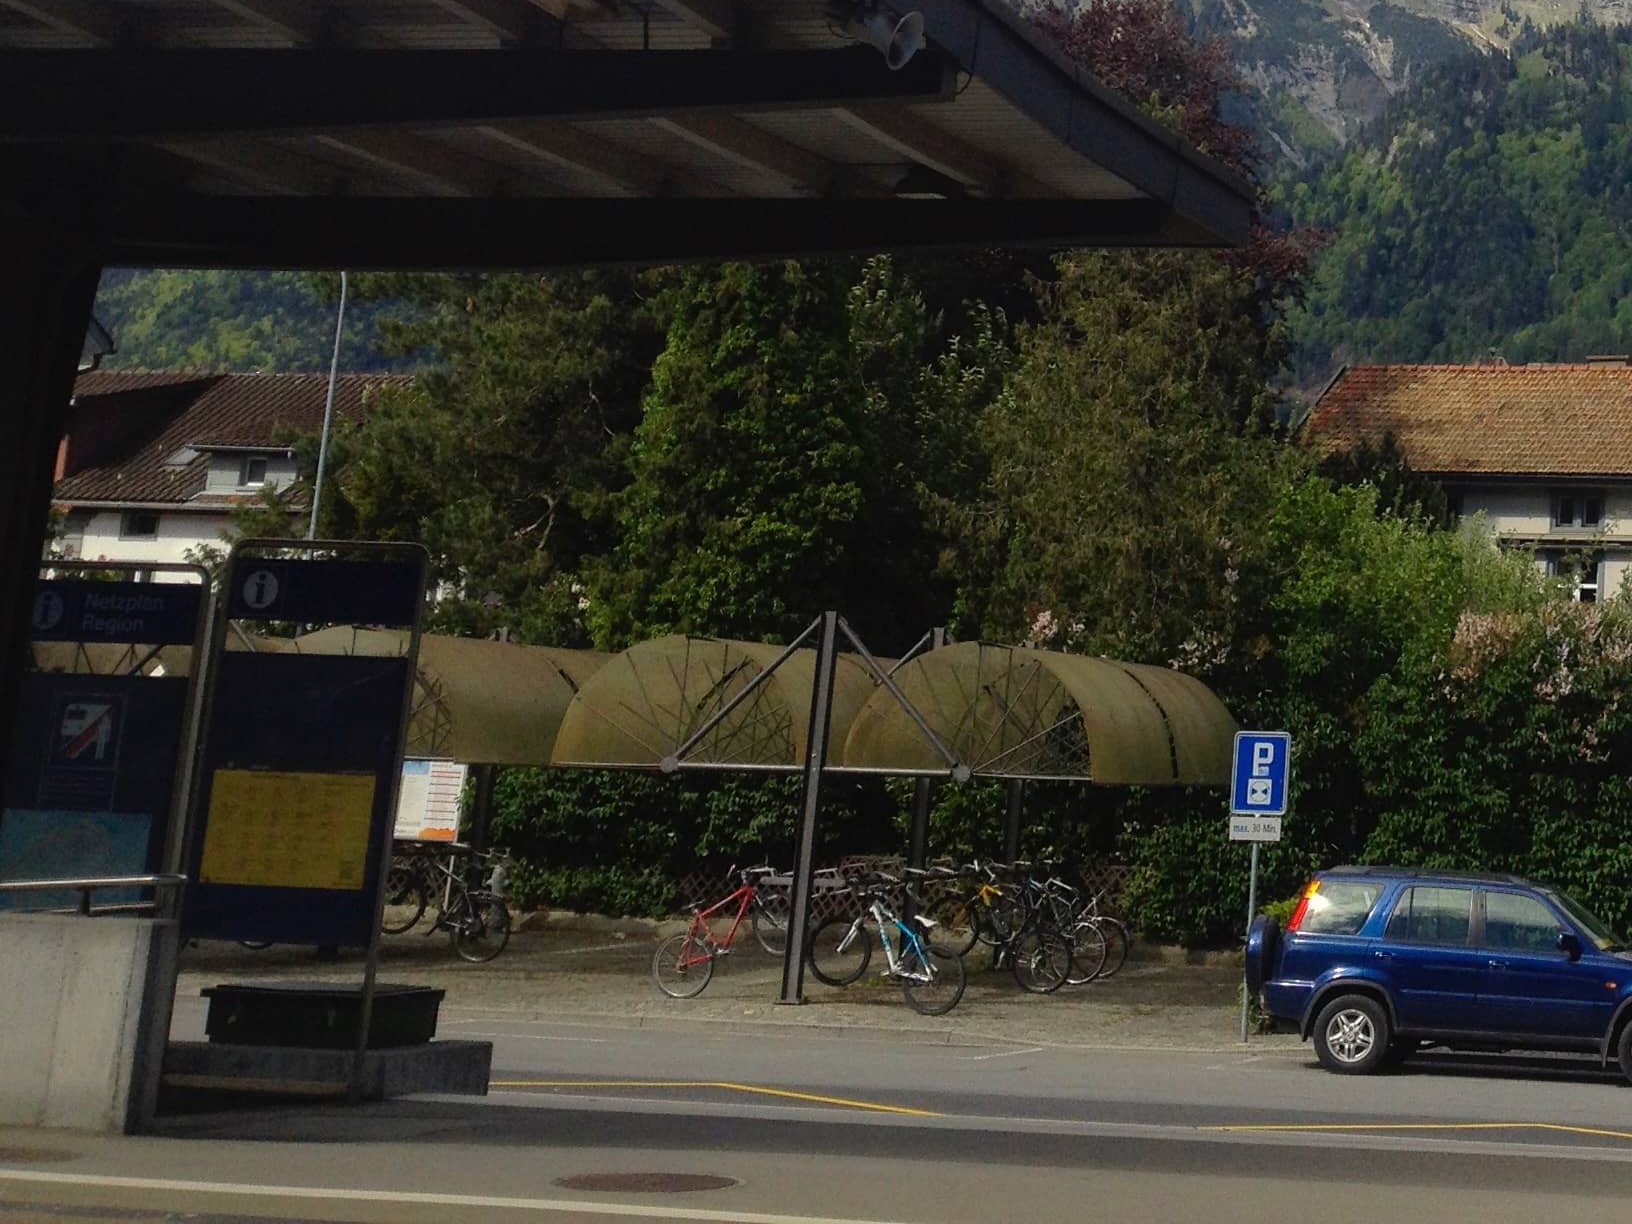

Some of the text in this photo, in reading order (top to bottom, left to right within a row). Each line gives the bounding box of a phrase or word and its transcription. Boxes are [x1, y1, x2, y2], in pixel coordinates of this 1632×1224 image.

[84, 592, 165, 613] Netzplan
[82, 614, 145, 635] Region
[1252, 742, 1274, 777] P
